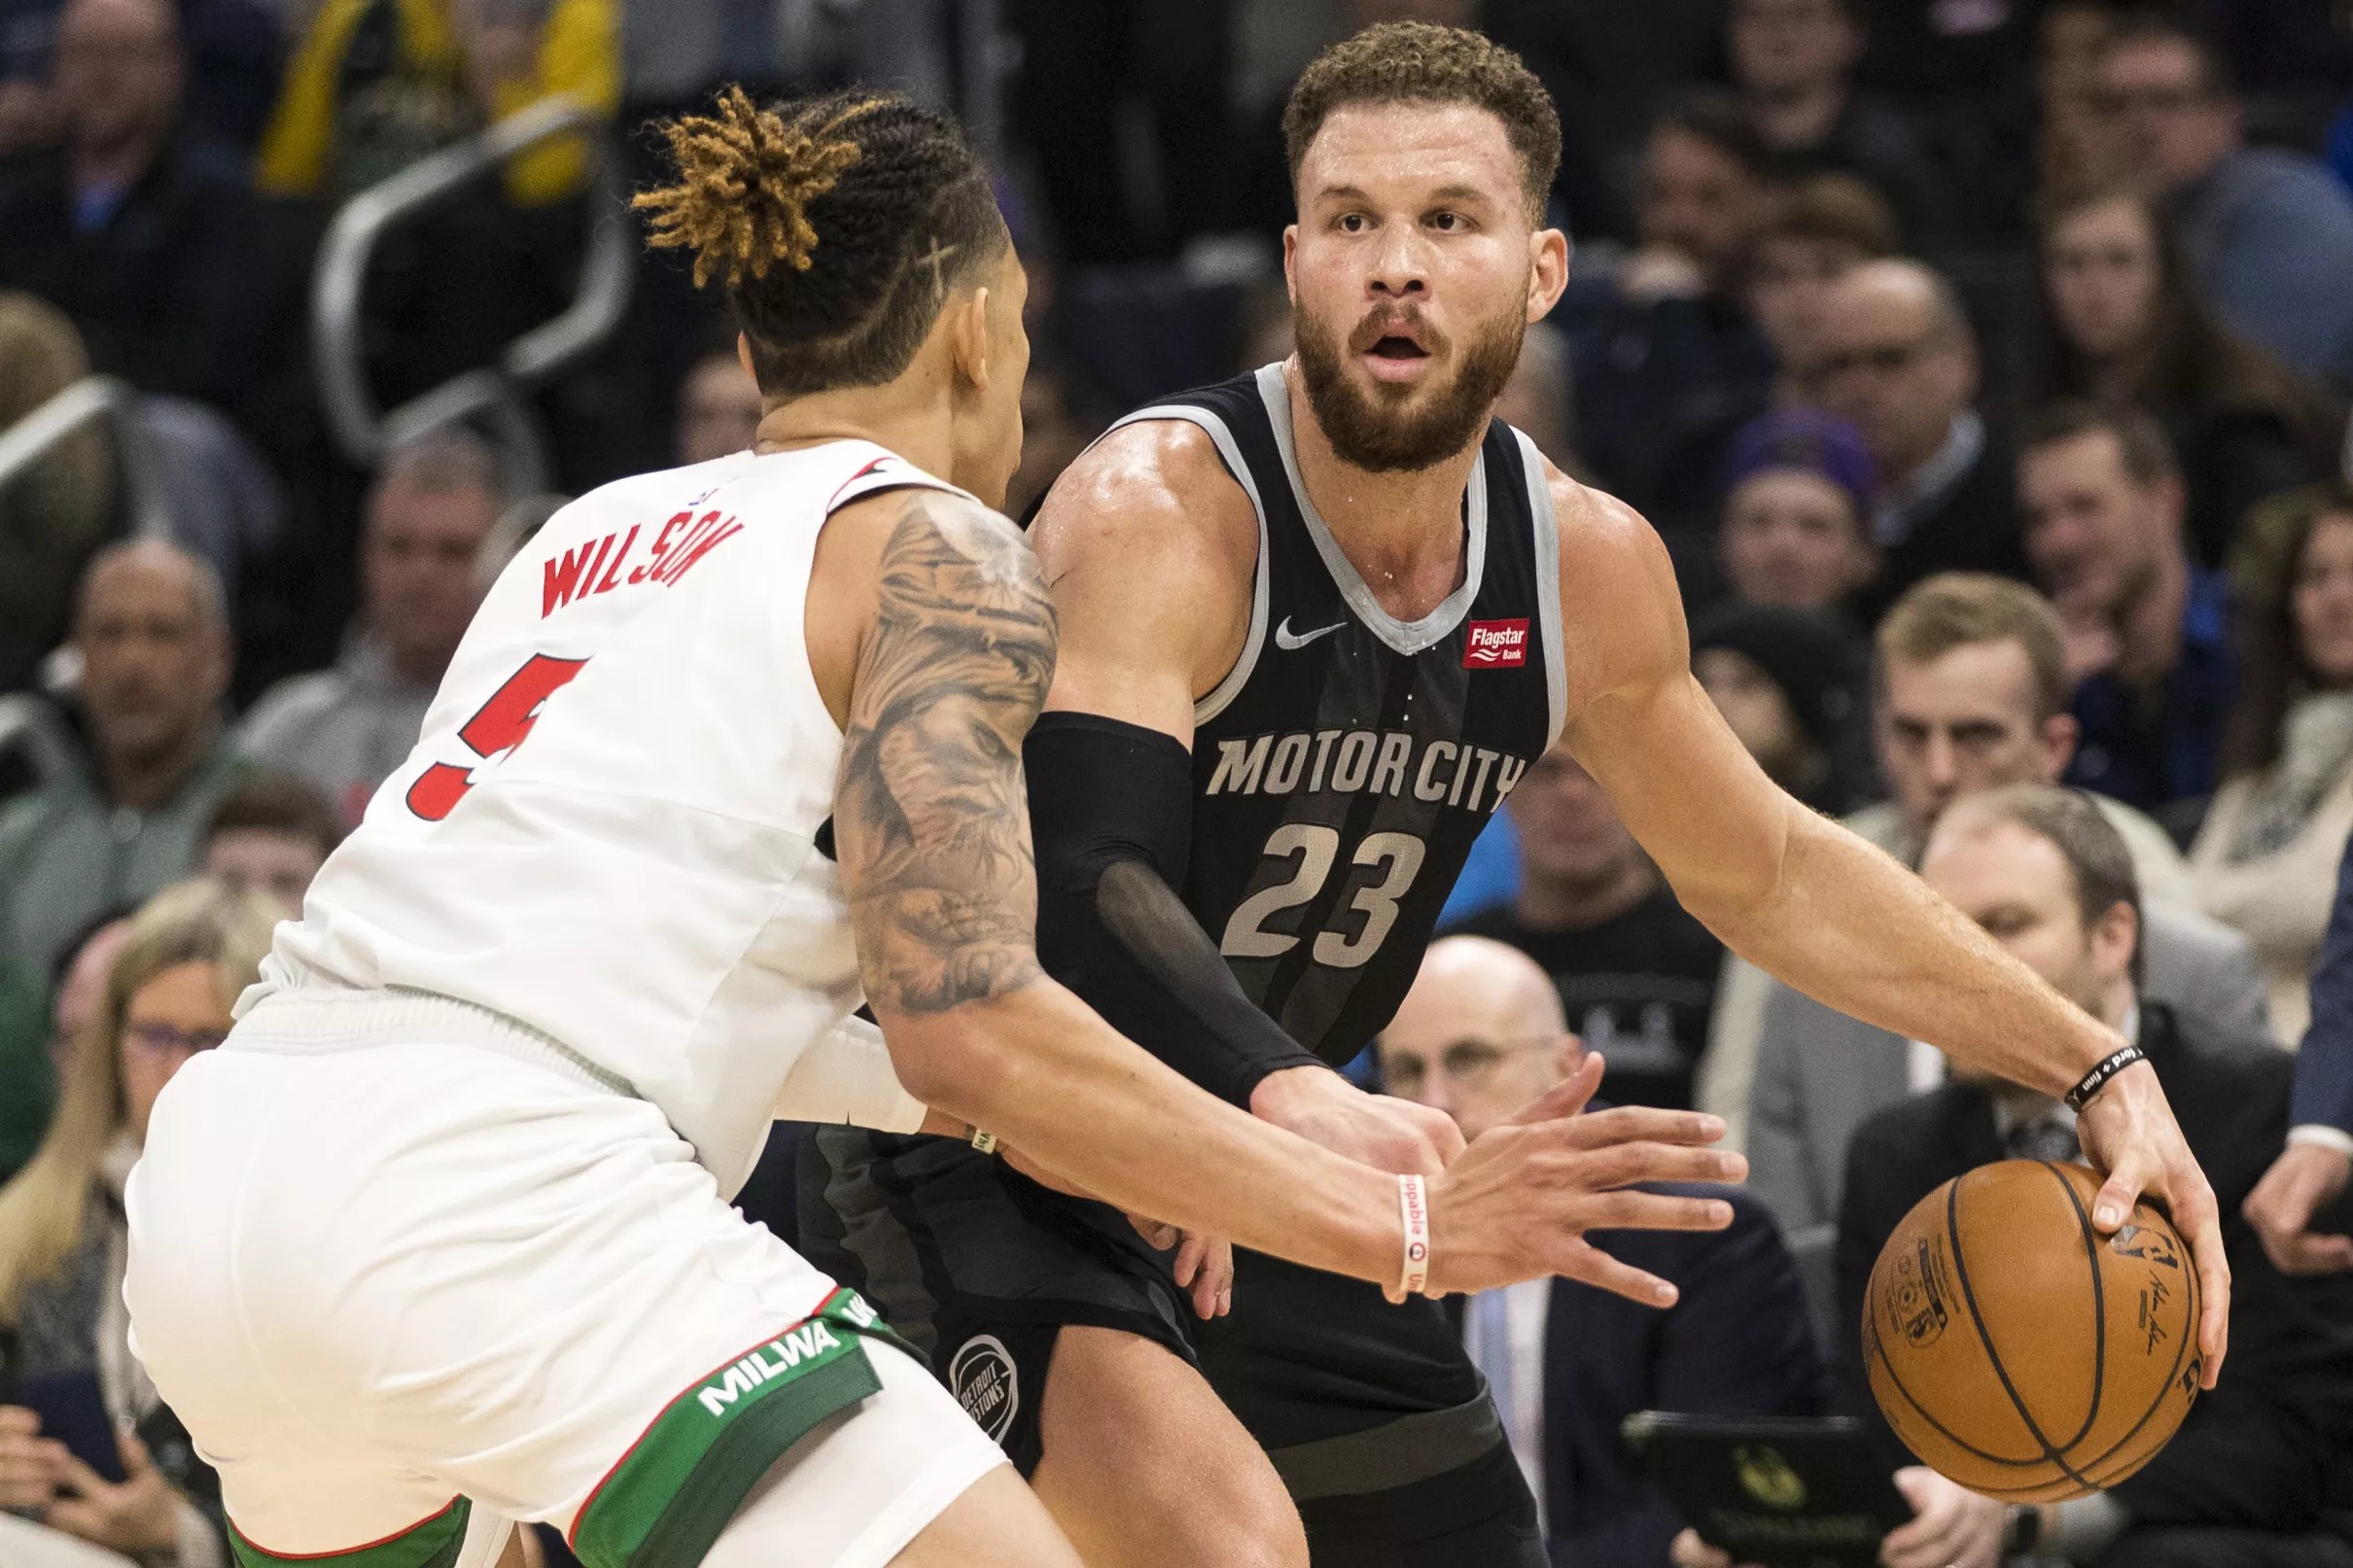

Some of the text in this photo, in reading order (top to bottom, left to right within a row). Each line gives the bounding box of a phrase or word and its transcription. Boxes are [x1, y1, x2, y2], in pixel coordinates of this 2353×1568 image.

[541, 509, 745, 619] WILSON
[1471, 627, 1525, 649] Flagstar
[1502, 649, 1522, 660] Bank
[1206, 728, 1526, 813] MOTOR CITY
[1219, 822, 1426, 968] 23
[961, 1360, 998, 1411] DETROIT
[968, 1379, 1005, 1422] ISTONS
